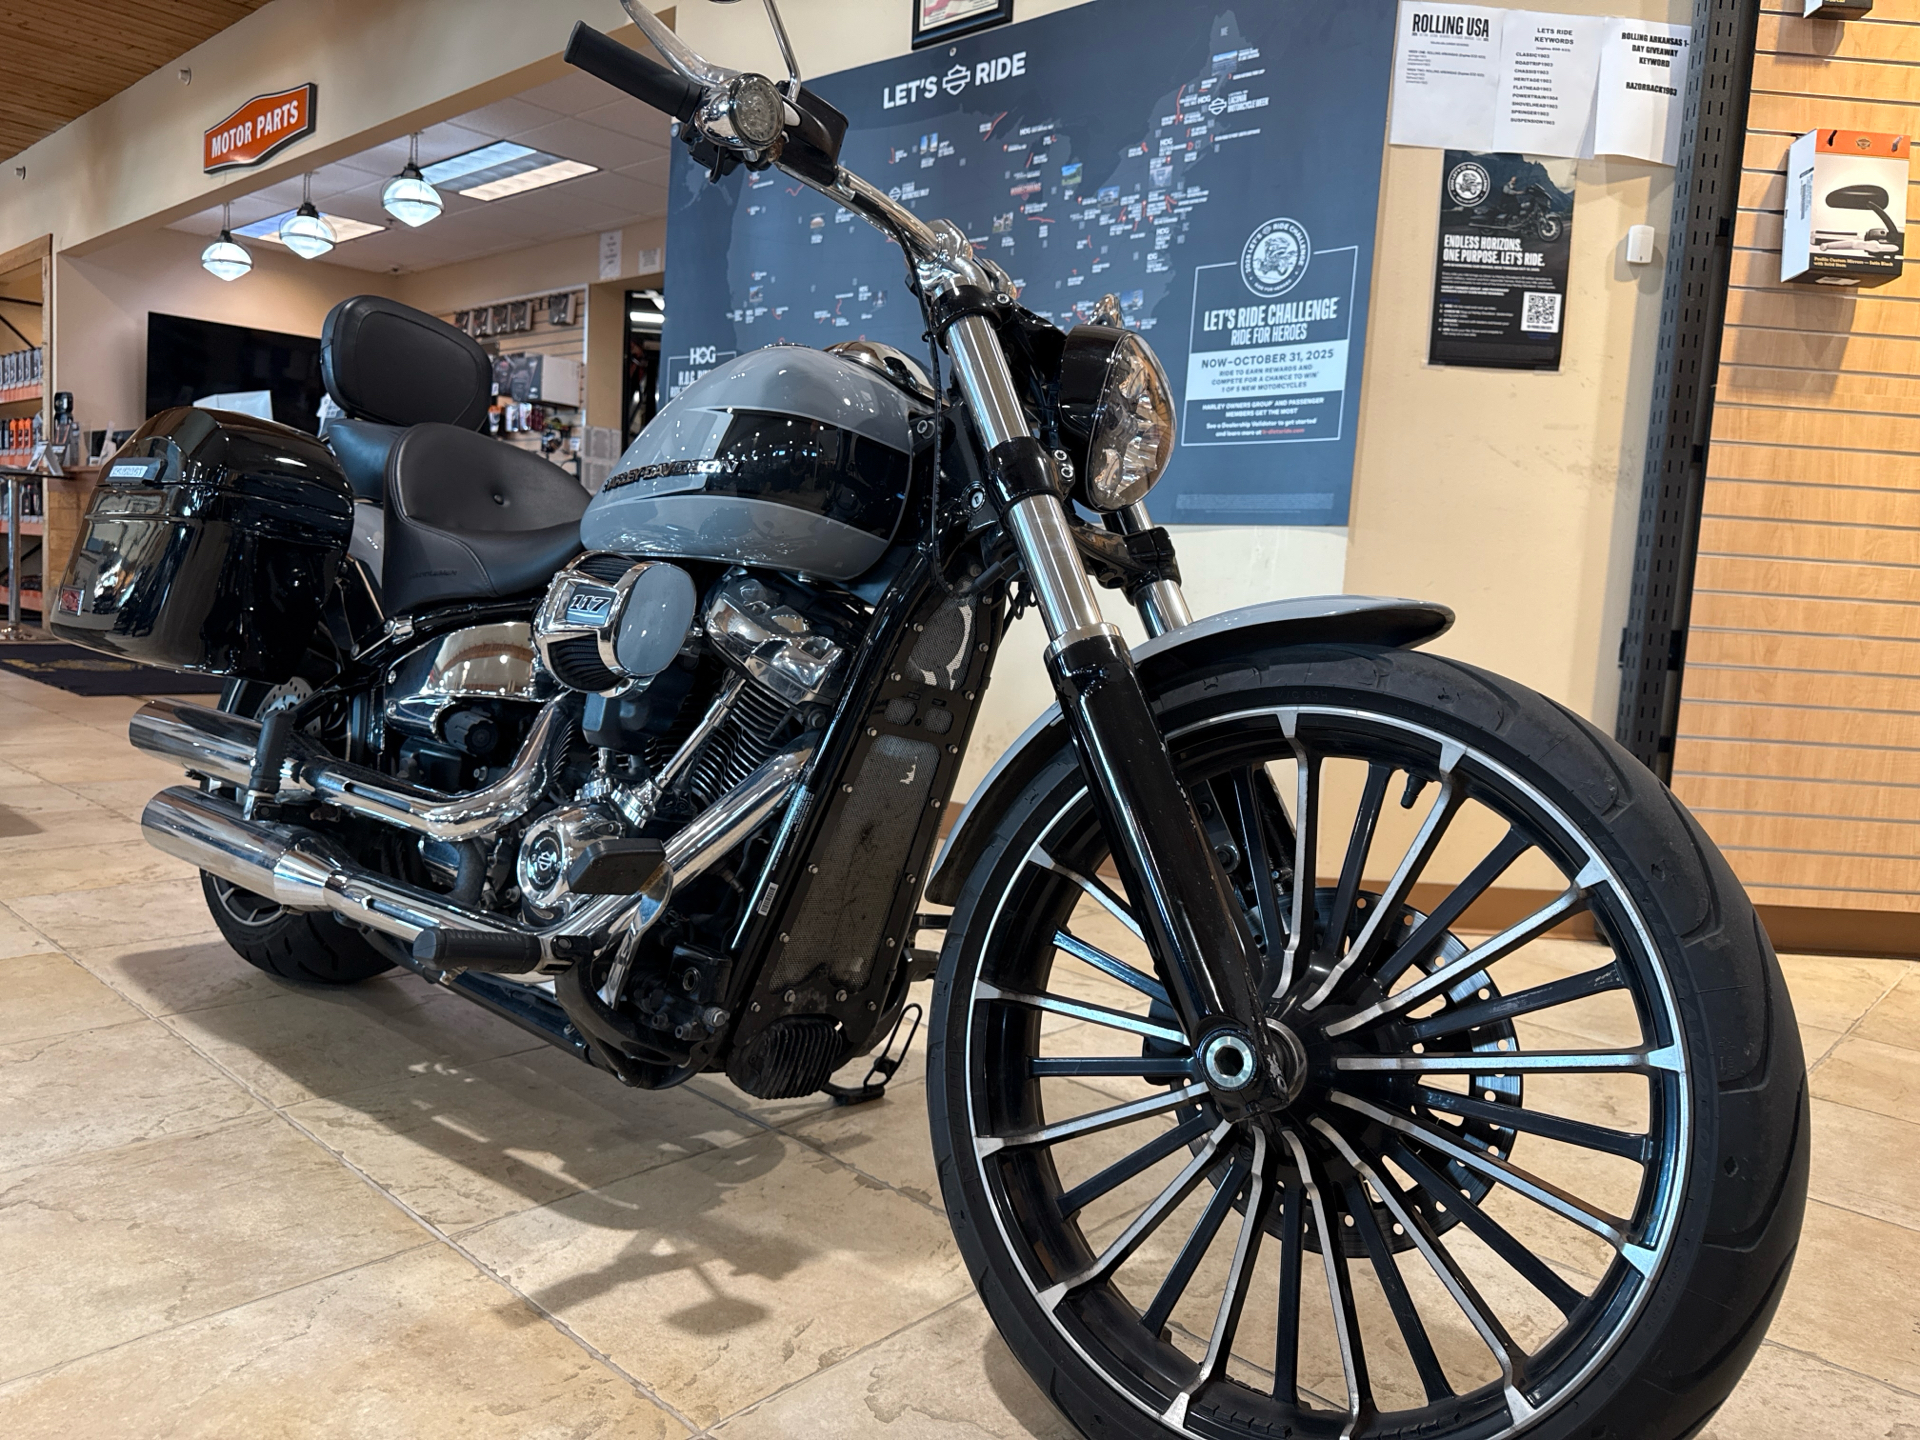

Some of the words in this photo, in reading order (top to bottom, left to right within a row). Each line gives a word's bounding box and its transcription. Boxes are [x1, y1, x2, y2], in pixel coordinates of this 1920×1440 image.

[1412, 14, 1464, 35] ROLLING
[1467, 17, 1489, 37] USA
[1621, 32, 1648, 42] ROLLING
[1649, 35, 1682, 46] ARKANSAS
[1646, 46, 1678, 57] GIVEAWAY
[1639, 57, 1670, 67] KEYWORD
[883, 76, 938, 109] LET'S
[975, 51, 1027, 86] RIDE
[1626, 82, 1677, 96] RAZORBACK1903
[211, 121, 252, 158] MOTOR
[256, 100, 298, 139] PARTS
[1273, 222, 1290, 230] RIDE
[1444, 234, 1479, 249] ENDLESS
[1481, 237, 1523, 251] HORIZONS.
[1443, 249, 1460, 261] ONE
[1461, 250, 1499, 264] PURPOSE.
[1501, 252, 1523, 265] LET'S
[1524, 253, 1545, 266] RIDE.
[1203, 308, 1236, 331] LET'S
[1237, 305, 1266, 328] RIDE
[1267, 297, 1339, 325] CHALLENGE
[1231, 329, 1252, 346] RIDE
[1253, 327, 1270, 344] FOR
[1272, 323, 1308, 342] HEROES
[689, 345, 716, 365] HOG
[1289, 352, 1303, 362] 31,
[1306, 349, 1334, 360] 2025
[1265, 366, 1297, 374] REWARDS
[1265, 374, 1292, 382] CHANCE
[1258, 382, 1307, 391] MOTORCYCLES
[1252, 400, 1273, 408] GROUP
[1289, 397, 1324, 405] PASSENGER
[1285, 419, 1294, 427] get
[602, 459, 741, 493] HARLEY-DAVIDSON
[568, 594, 611, 613] 117
